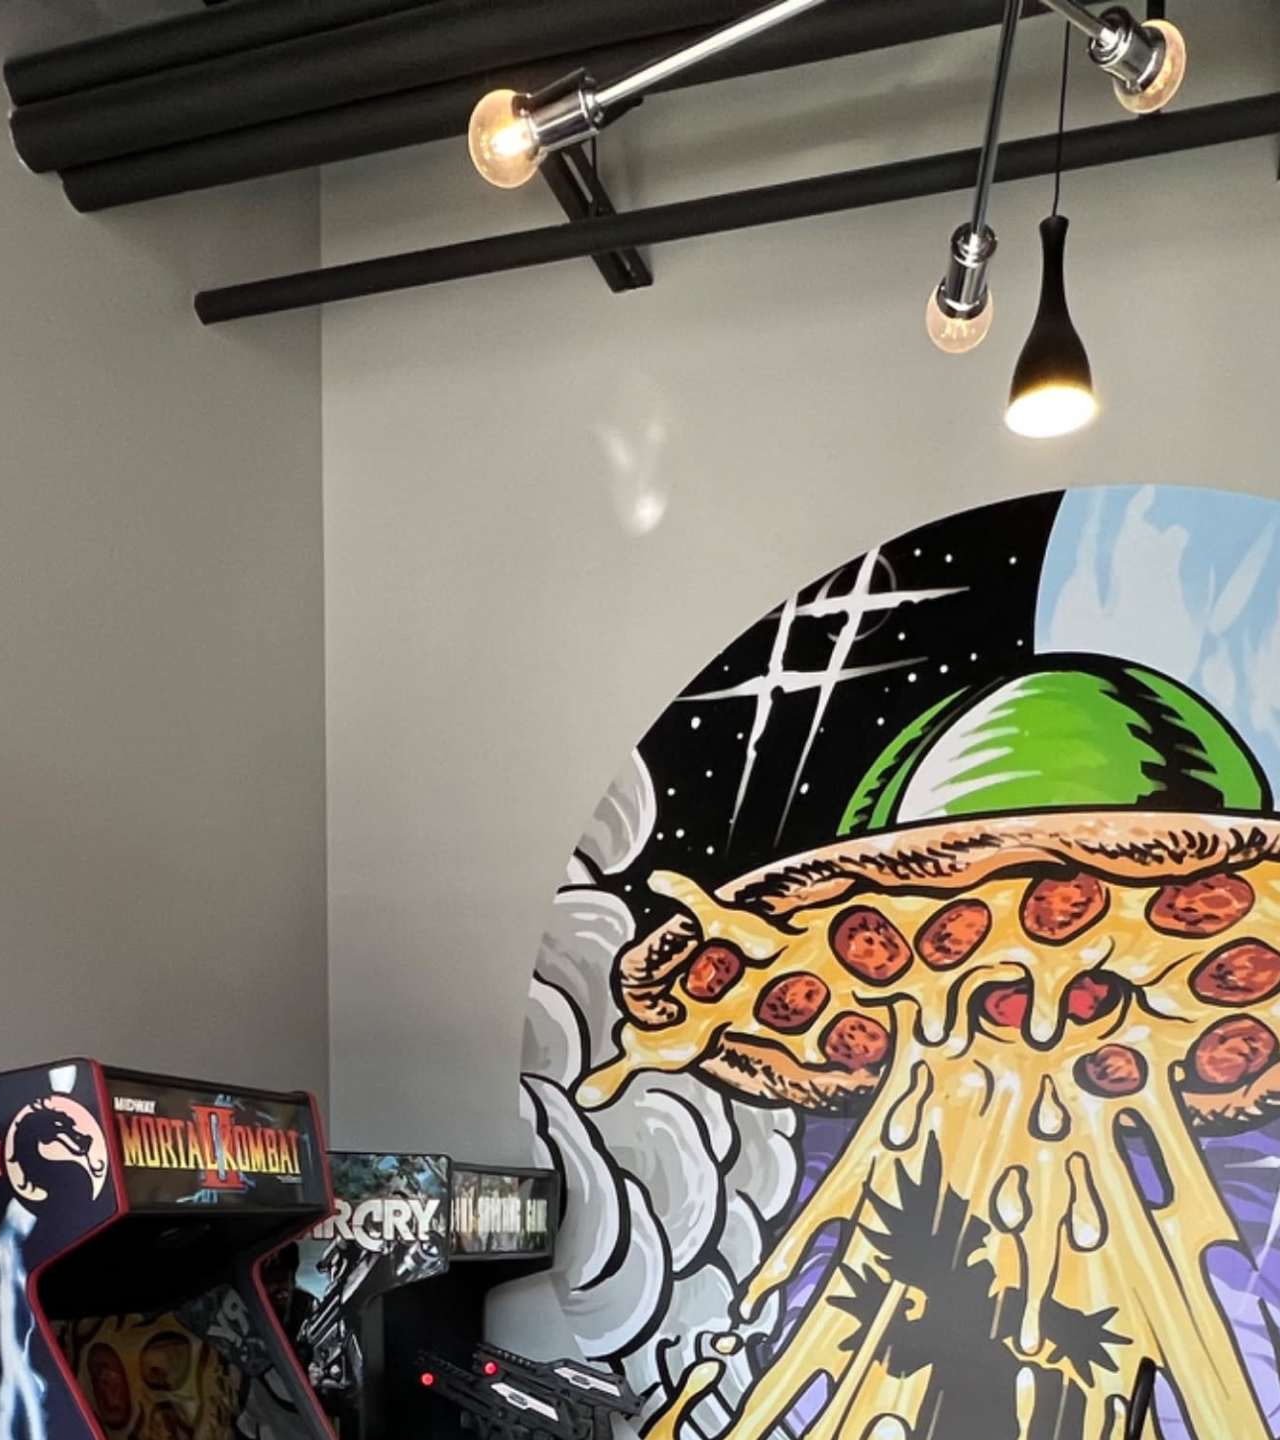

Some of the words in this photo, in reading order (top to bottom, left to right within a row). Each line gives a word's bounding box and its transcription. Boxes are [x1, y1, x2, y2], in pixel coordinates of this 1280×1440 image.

[114, 1097, 157, 1114] MIDWAY
[118, 1113, 218, 1172] MORTAL
[220, 1122, 301, 1175] KOMBAT
